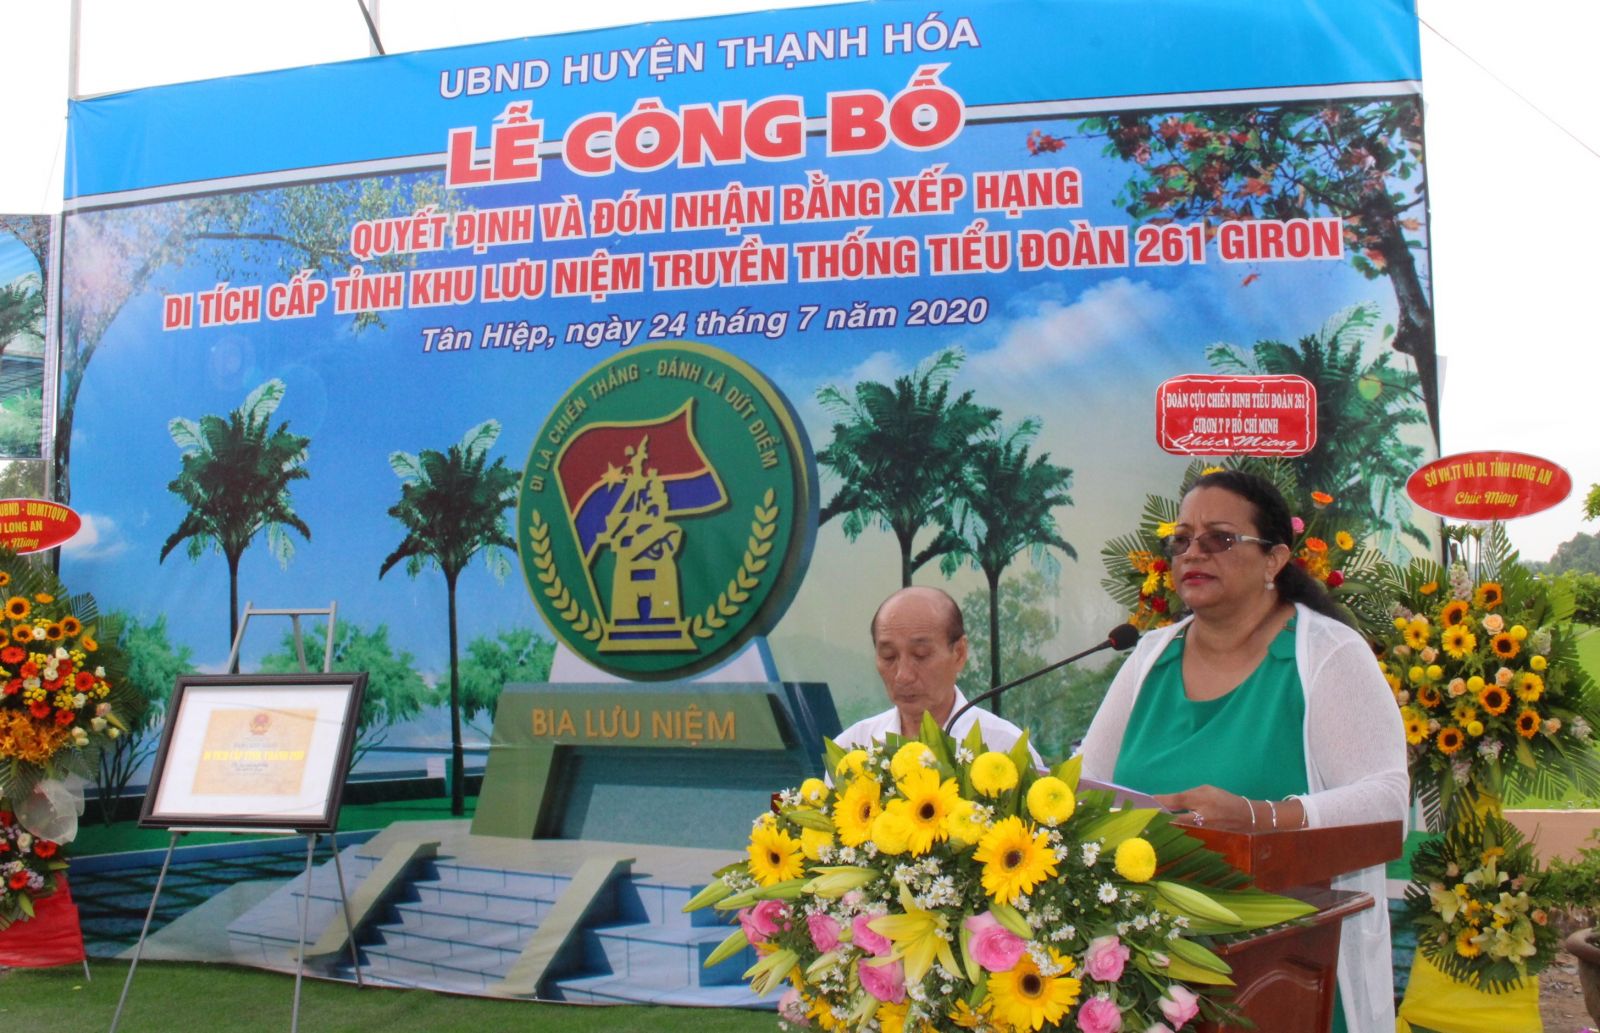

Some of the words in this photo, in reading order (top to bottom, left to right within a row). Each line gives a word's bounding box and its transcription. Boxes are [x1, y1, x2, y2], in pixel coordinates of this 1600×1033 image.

[440, 58, 550, 99] UBND
[562, 38, 705, 82] HUYỆN
[718, 25, 868, 70] THẠNH
[883, 11, 981, 55] HÓA
[447, 102, 541, 187] LỄ
[564, 98, 803, 175] CÔNG
[828, 64, 964, 155] BỐ
[352, 207, 448, 259] QUYẾT
[455, 208, 533, 253] ĐỊNH
[543, 196, 583, 239] VÀ
[593, 191, 662, 235] ĐÓN
[673, 183, 771, 233] NHẬN
[783, 172, 881, 221] BẰNG
[892, 166, 965, 215] XẾP
[976, 170, 1079, 216] HẠNG
[165, 295, 191, 328] DI
[201, 283, 260, 325] TÍCH
[268, 272, 325, 319] CẤP
[335, 267, 403, 312] TỈNH
[411, 269, 475, 305] KHU
[484, 261, 545, 300] LƯU
[554, 252, 641, 299] NIỆM
[653, 237, 785, 288] TRUYỀN
[797, 229, 917, 279] THỐNG
[928, 221, 1008, 273] TIỂU
[1020, 223, 1126, 267] ĐOÀN
[1138, 226, 1203, 262] 261
[1220, 220, 1341, 260] GIRON
[421, 326, 473, 352] Tân
[480, 320, 555, 352] Hiệp,
[564, 314, 645, 350] ngày
[648, 312, 688, 339] 24
[695, 305, 788, 338] tháng
[798, 305, 821, 332] 7
[825, 302, 897, 330] năm
[905, 297, 989, 327] 2020
[656, 357, 702, 382] ĐÁNH
[703, 370, 728, 393] LÀ
[1166, 389, 1188, 408] ĐOÀN
[1258, 418, 1279, 434] MINH
[1511, 463, 1537, 481] LONG
[1537, 468, 1553, 486] AN
[4, 521, 28, 534] LONG
[30, 520, 43, 532] AN
[532, 708, 577, 737] BIA
[585, 705, 642, 739] LƯU
[652, 703, 737, 746] NIỆM
